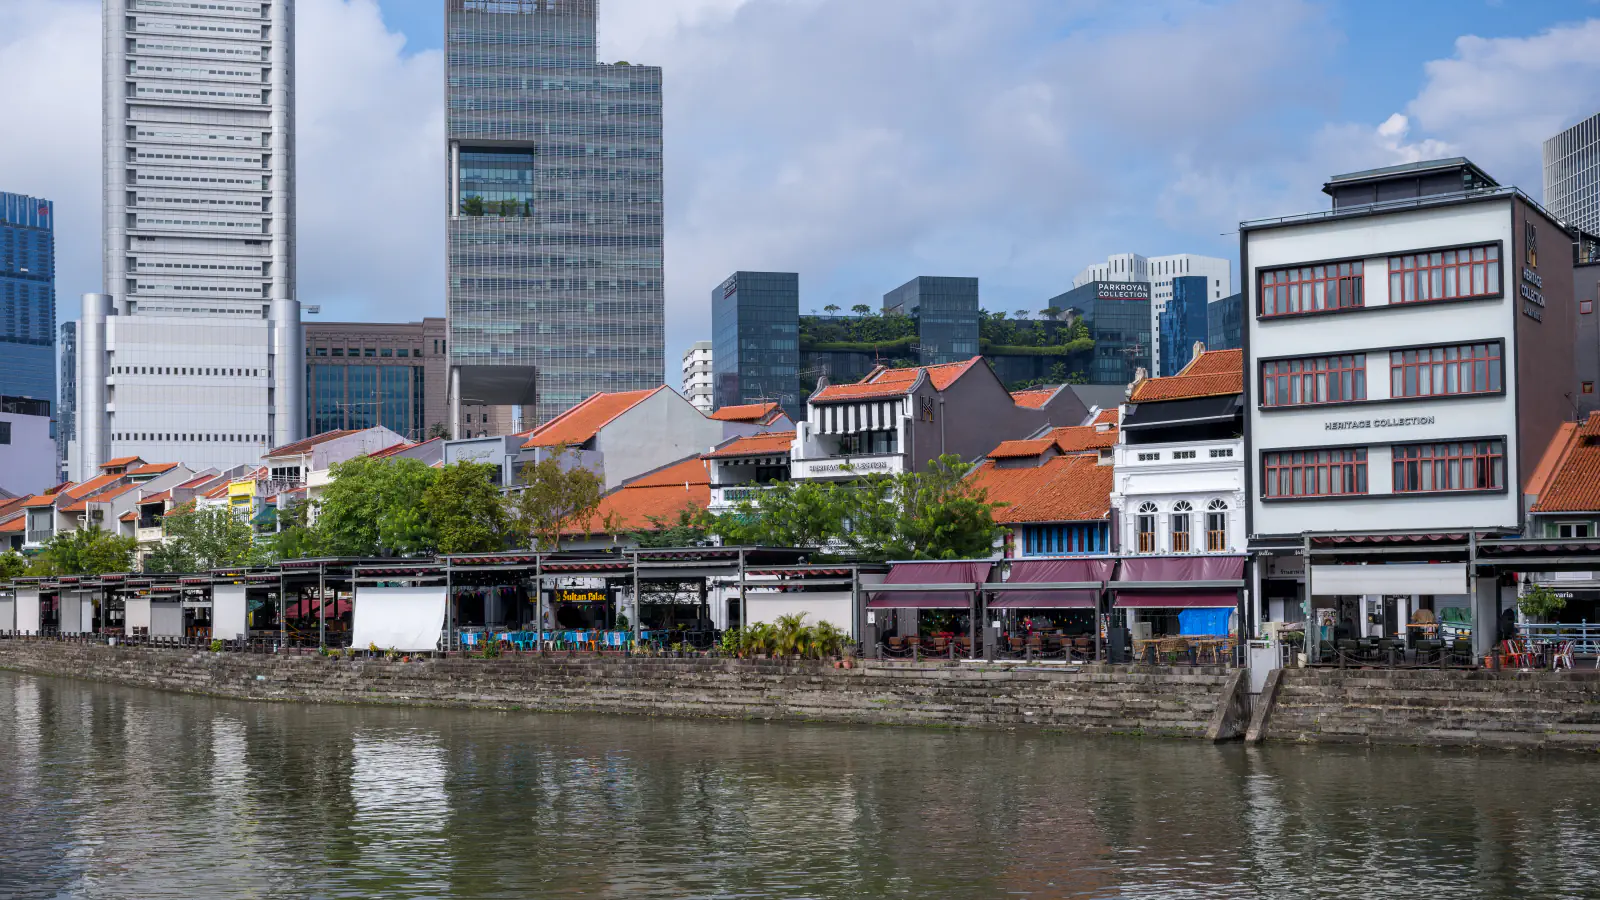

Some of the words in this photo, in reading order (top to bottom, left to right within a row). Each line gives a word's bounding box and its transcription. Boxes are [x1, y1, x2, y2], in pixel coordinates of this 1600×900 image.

[1523, 268, 1542, 289] HERITAGE
[1520, 283, 1546, 308] COLLECTION
[1324, 420, 1371, 431] HERITAGE
[1373, 416, 1435, 428] COLLECTION
[809, 463, 842, 473] HERITAG
[849, 461, 887, 471] LLECTION
[562, 590, 587, 601] Sultan
[587, 592, 607, 601] Palac
